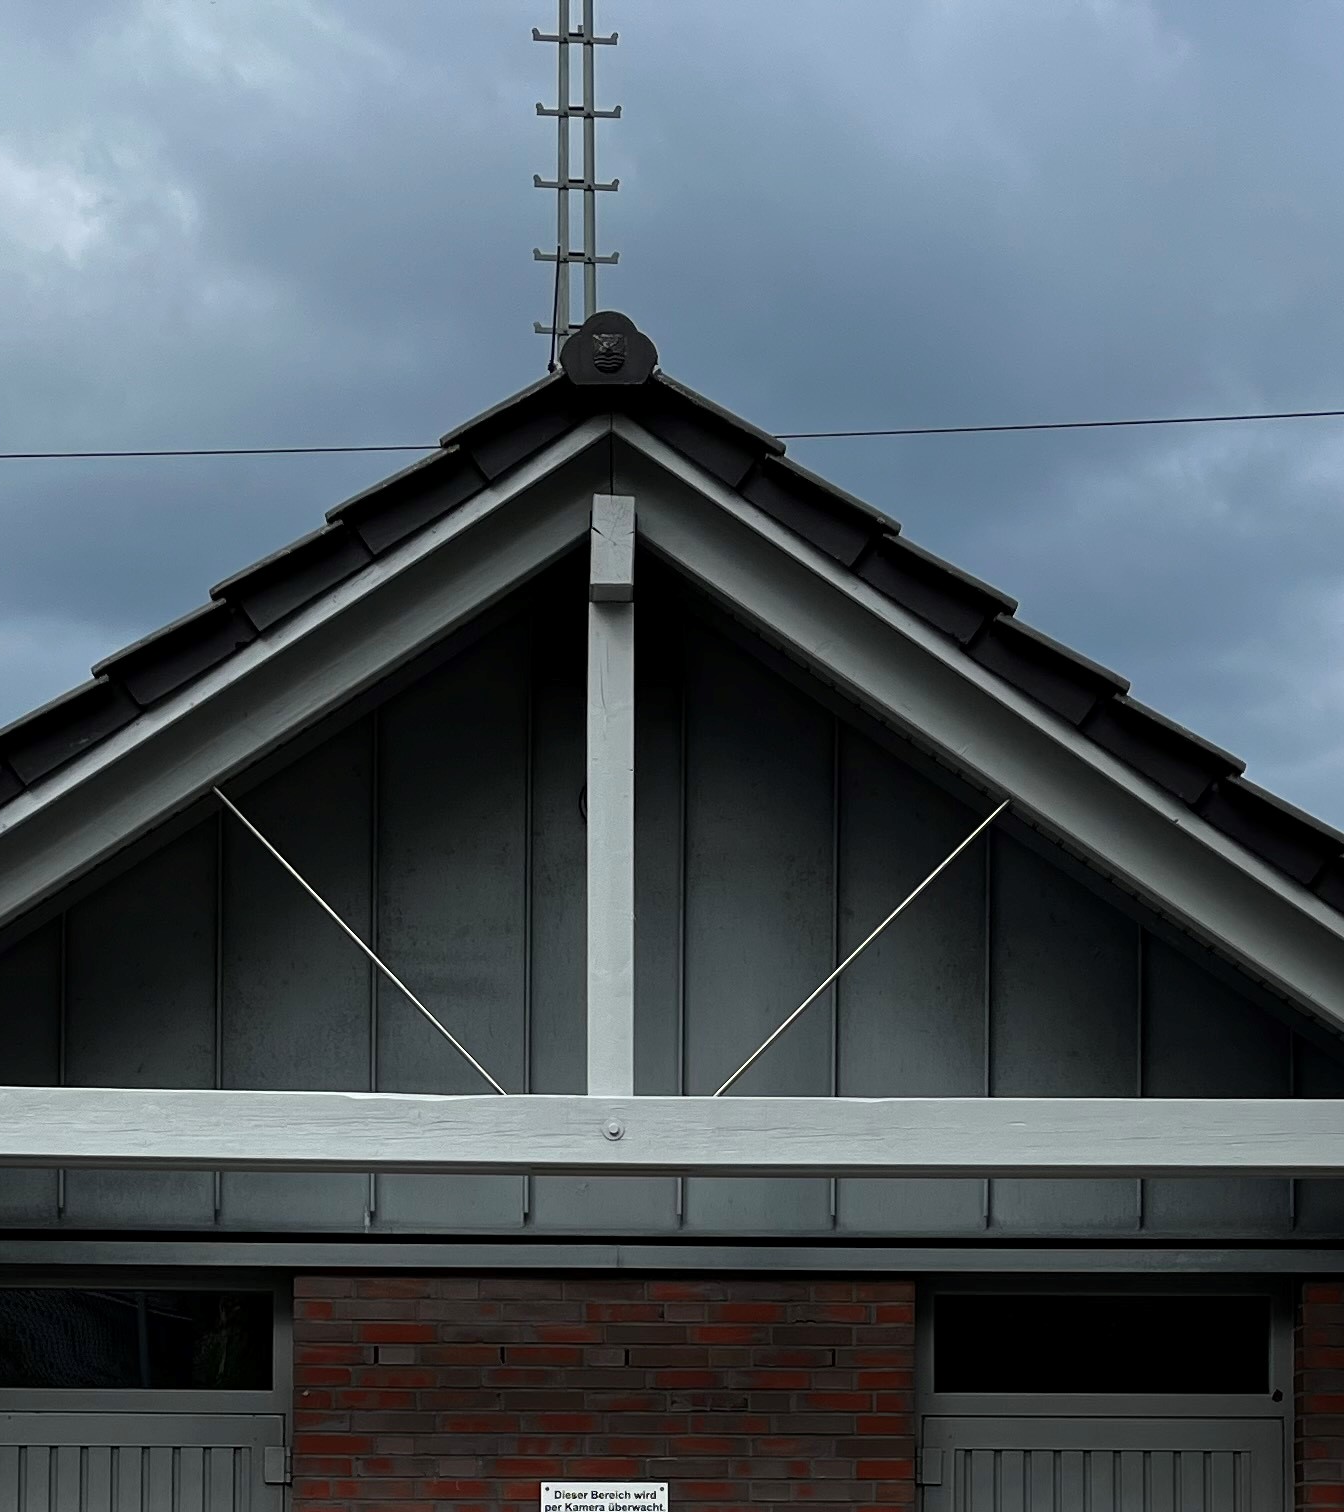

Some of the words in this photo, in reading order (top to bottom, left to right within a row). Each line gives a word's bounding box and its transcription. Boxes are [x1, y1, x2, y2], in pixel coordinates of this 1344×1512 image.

[554, 1490, 588, 1500] Dieser
[591, 1490, 631, 1500] Bereich
[634, 1490, 657, 1500] wird
[565, 1503, 605, 1512] Kamera
[608, 1502, 666, 1512] überwacht.
